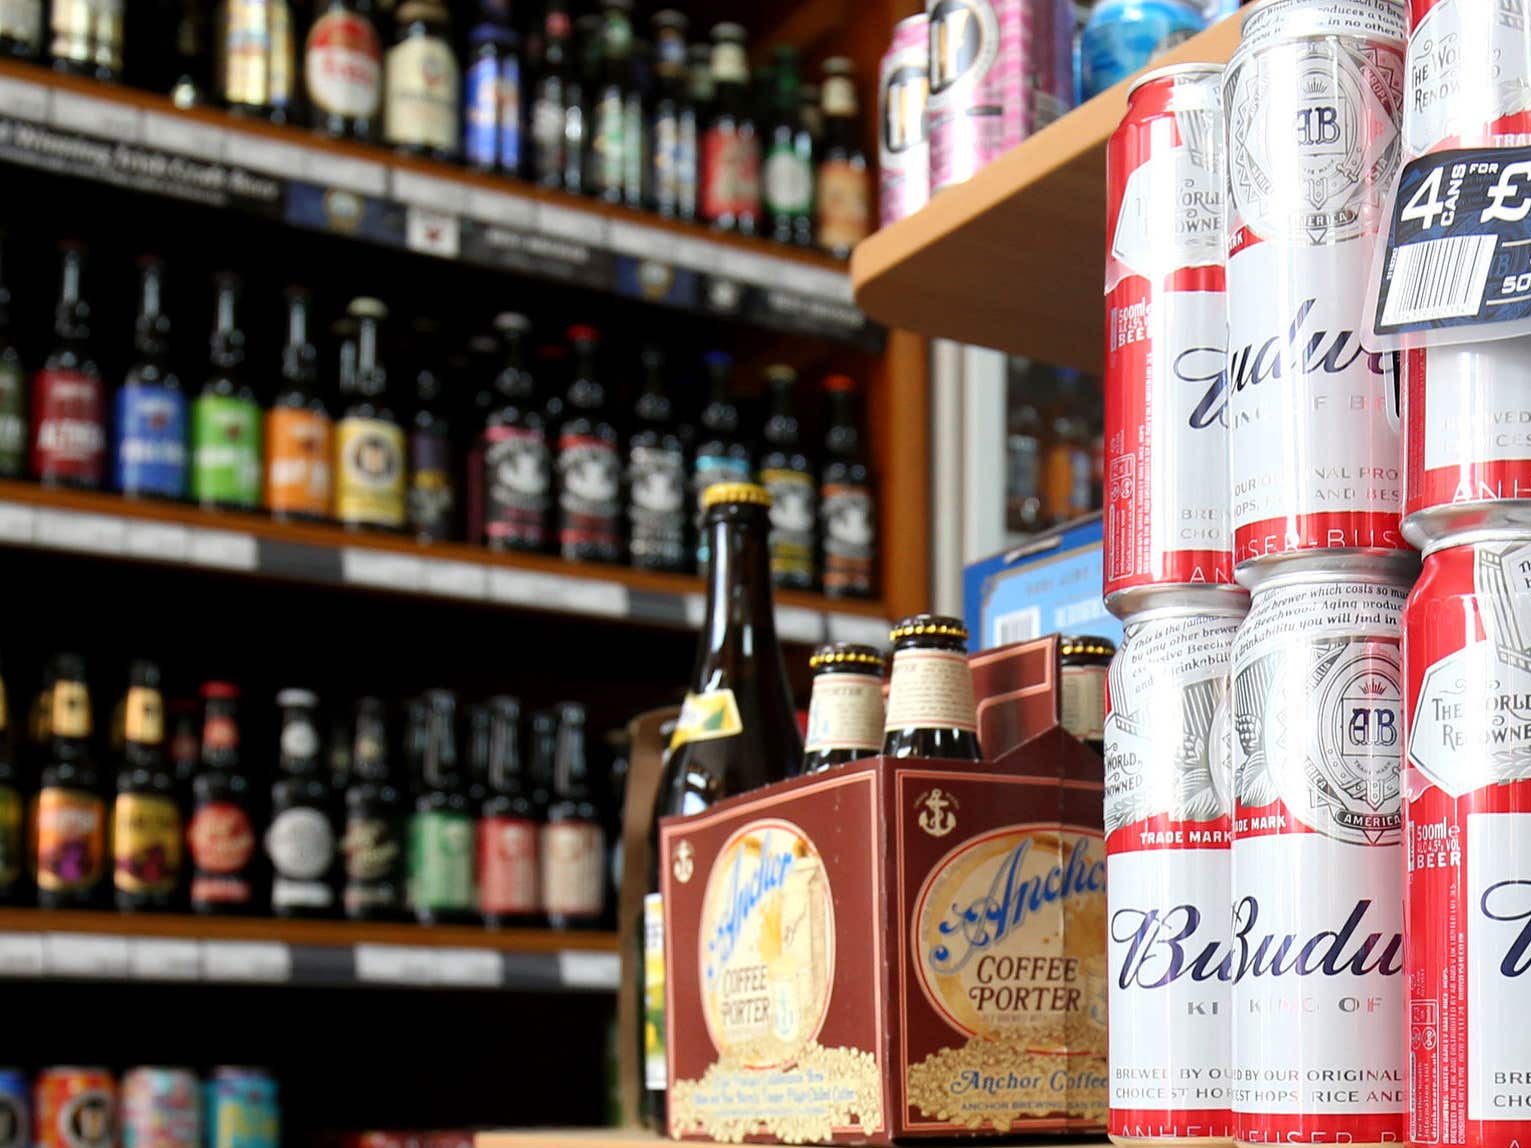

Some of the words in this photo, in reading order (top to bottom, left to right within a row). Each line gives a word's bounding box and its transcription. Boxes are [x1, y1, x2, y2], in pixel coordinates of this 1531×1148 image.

[1344, 20, 1361, 28] no
[1364, 22, 1396, 36] other
[1469, 163, 1499, 174] FOR
[1401, 166, 1444, 230] 4
[1440, 163, 1467, 227] CANS
[1310, 583, 1343, 600] which
[1376, 586, 1388, 596] so
[1327, 612, 1351, 625] will
[1385, 613, 1398, 625] in
[1431, 698, 1464, 723] THE
[1251, 815, 1287, 830] MARK
[1140, 831, 1184, 846] TRADE
[1416, 851, 1462, 869] BEER
[976, 954, 1079, 985] COFFEE
[722, 964, 768, 999] COFFEE
[968, 985, 1083, 1013] PORTER
[720, 999, 771, 1026] PORTER
[950, 1069, 1042, 1094] Anchor
[1306, 1069, 1403, 1082] ORIGINAL
[1312, 1088, 1360, 1103] RICE
